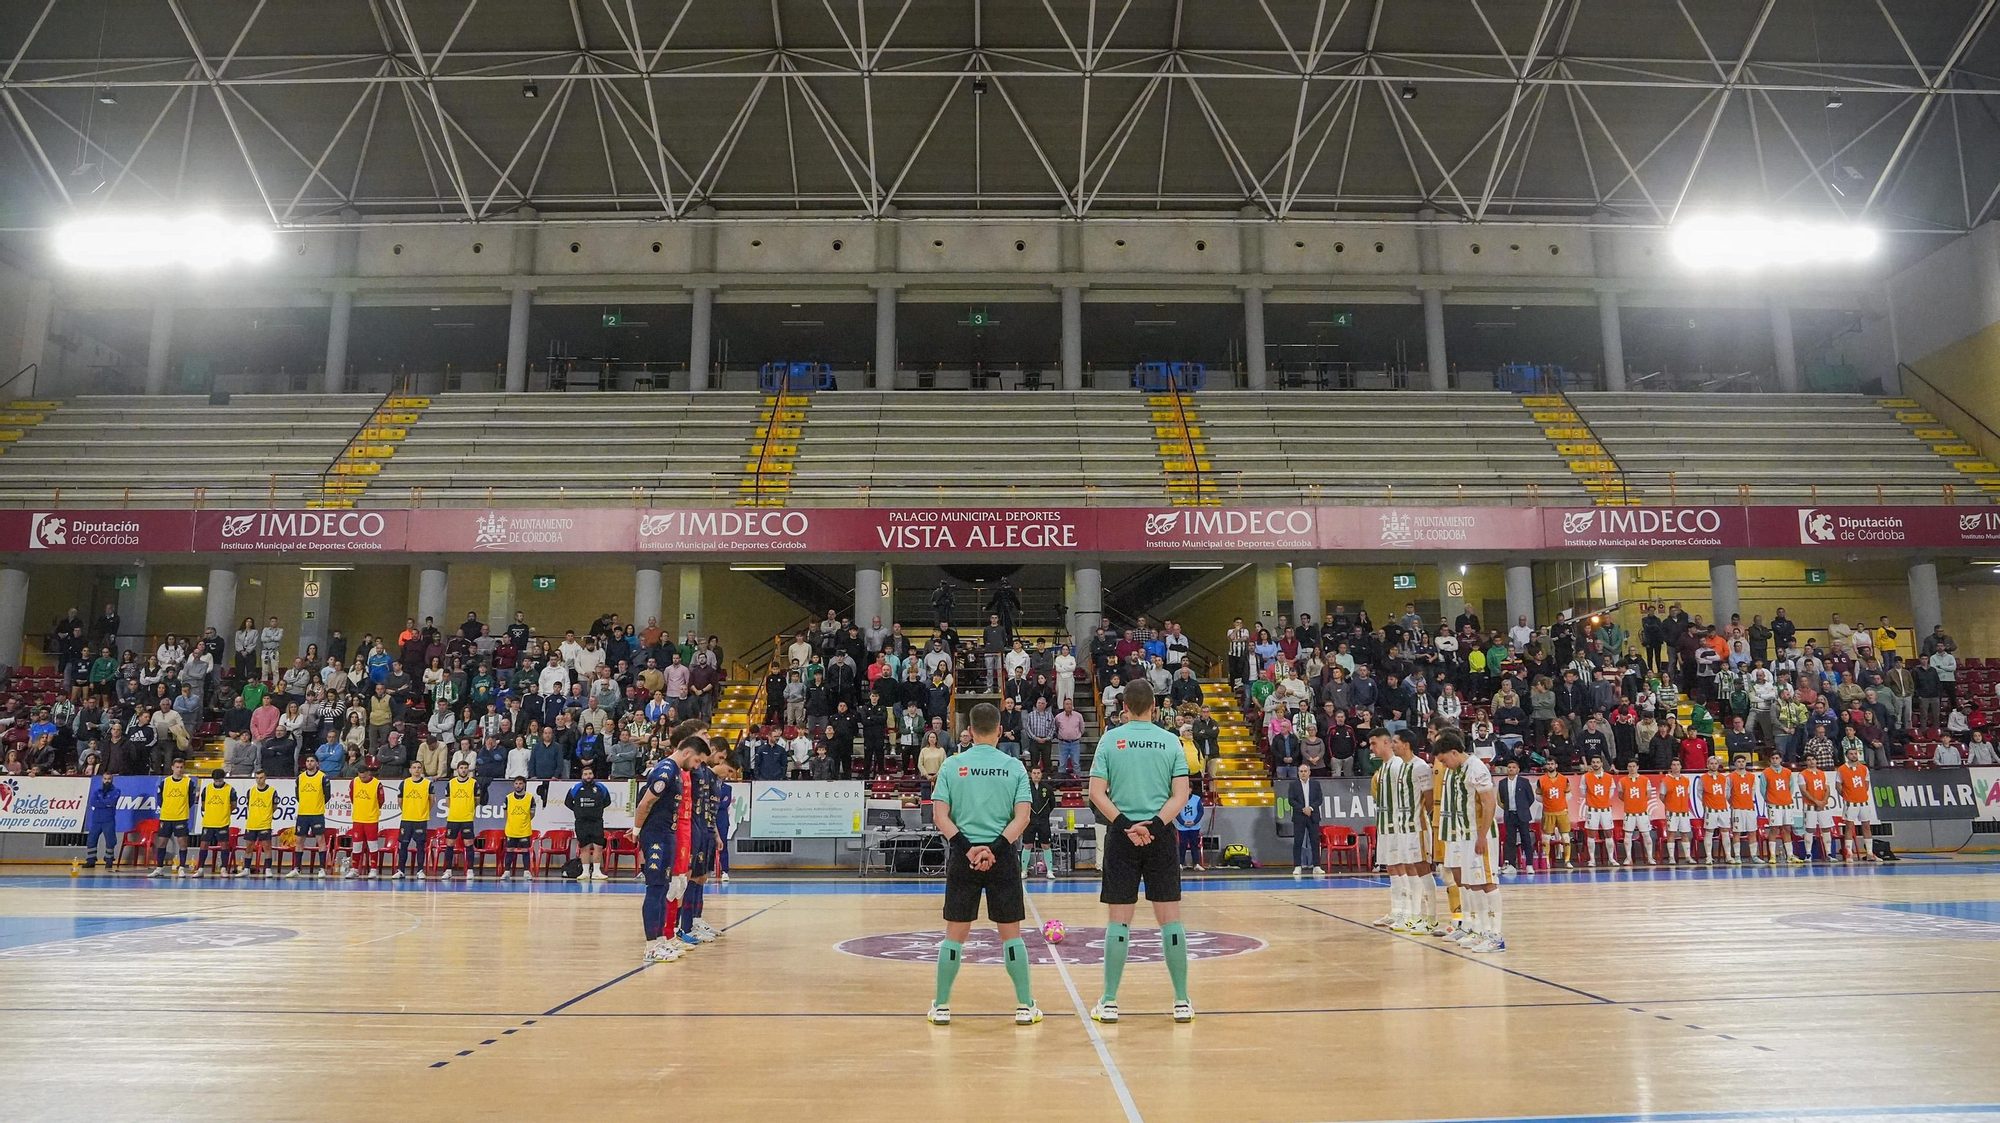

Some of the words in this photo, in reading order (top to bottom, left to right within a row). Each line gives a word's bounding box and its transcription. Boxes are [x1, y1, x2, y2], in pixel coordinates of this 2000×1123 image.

[608, 316, 616, 326] 2
[975, 314, 982, 324] 3
[1338, 316, 1346, 324] 4
[1688, 319, 1696, 328] 5
[889, 512, 938, 522] PALACIO
[940, 512, 1003, 522] MUNICIPAL
[1005, 512, 1061, 522] DEPORTES
[1413, 516, 1475, 528] AYUNTAMIENTO
[1600, 510, 1721, 534] IMDECO
[72, 520, 140, 534] Diputación
[260, 512, 385, 537] IMDECO
[510, 519, 573, 530] AYUNTAMIENTO
[679, 512, 809, 537] IMDECO
[1184, 511, 1312, 536] IMDECO
[1838, 516, 1903, 530] Diputación
[71, 534, 87, 546] de
[90, 533, 140, 546] Córdoba
[510, 532, 520, 542] DE
[876, 526, 956, 548] VISTA
[965, 525, 1078, 548] ALEGRE
[1414, 530, 1425, 540] DE
[1840, 529, 1854, 540] de
[1856, 528, 1905, 540] Córdoba
[221, 541, 254, 550] Instituto
[255, 541, 294, 552] Municipal
[296, 541, 306, 550] de
[308, 542, 346, 552] Deportes
[347, 541, 382, 550] Córdoba
[640, 540, 673, 550] Instituto
[675, 540, 716, 551] Municipal
[718, 541, 728, 550] de
[730, 541, 770, 551] Deportes
[771, 540, 807, 550] Córdoba
[1146, 540, 1180, 548] Instituto
[1182, 540, 1223, 550] Municipal
[1224, 540, 1235, 548] de
[1237, 540, 1276, 550] Deportes
[1277, 538, 1312, 548] Córdoba
[1564, 538, 1598, 546] Instituto
[1599, 538, 1637, 548] Municipal
[1639, 538, 1649, 547] de
[1651, 538, 1687, 549] Deportes
[1688, 538, 1722, 548] Córdoba
[1400, 575, 1410, 587] D
[1812, 571, 1820, 582] E
[120, 577, 130, 588] A
[539, 578, 549, 588] B
[1128, 740, 1166, 750] WÜRTH
[971, 768, 1009, 777] WÜRTH
[1898, 784, 1975, 807] MILAR
[13, 794, 83, 814] pidetaxi
[0, 817, 32, 830] mpre
[32, 816, 77, 832] contigo
